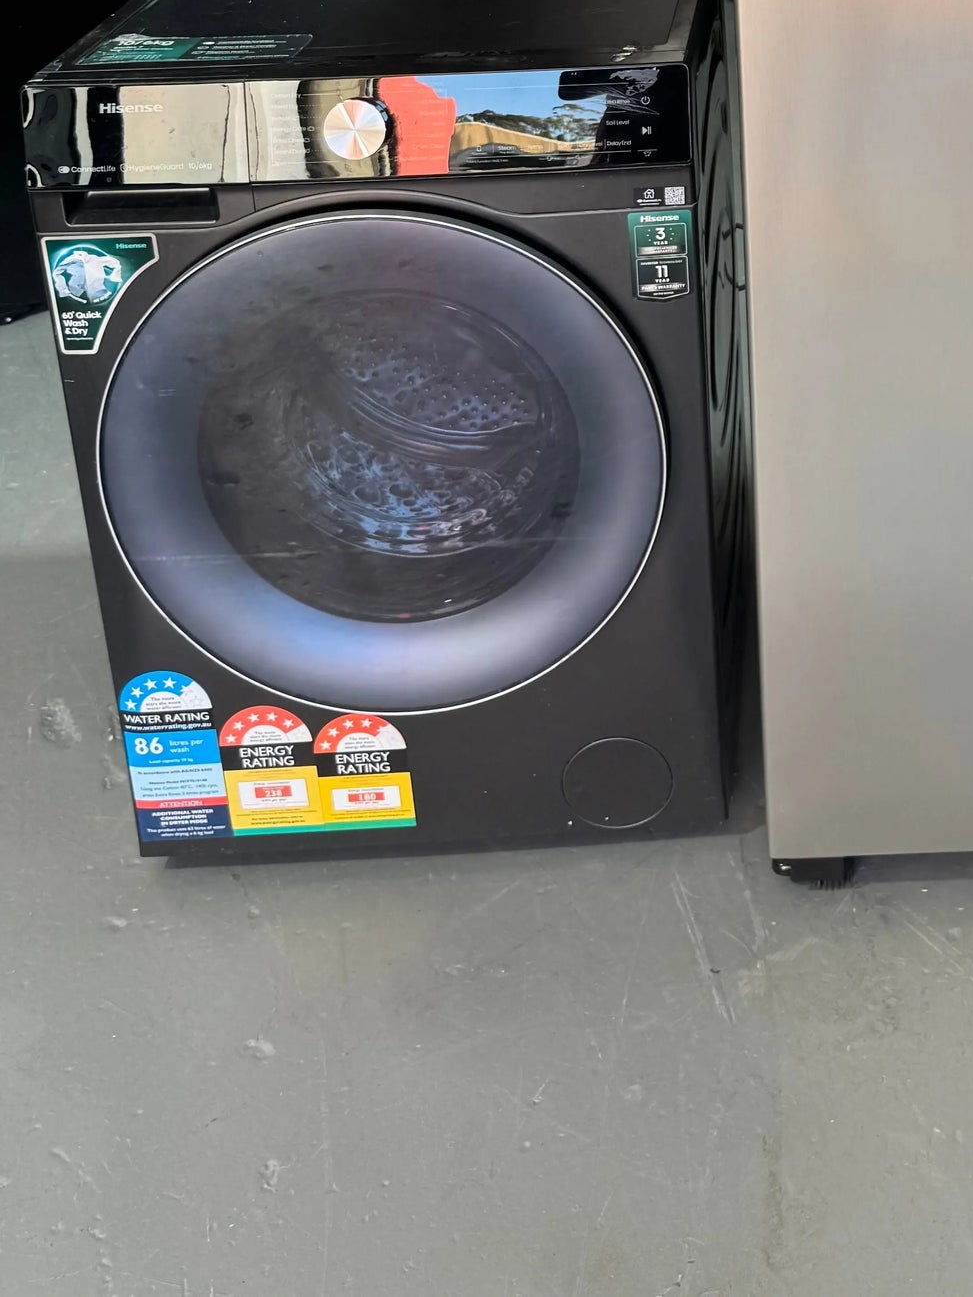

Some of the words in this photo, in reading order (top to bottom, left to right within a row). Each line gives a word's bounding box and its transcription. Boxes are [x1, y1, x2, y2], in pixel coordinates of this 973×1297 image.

[99, 103, 163, 113] Hisense
[655, 227, 665, 240] 3
[656, 265, 668, 278] 11
[76, 311, 102, 319] Quick
[124, 714, 162, 723] WATER
[165, 712, 210, 722] RATING
[125, 722, 211, 731] www.waterrating.gov.au
[134, 737, 163, 755] 86
[240, 745, 294, 757] ENERGY
[242, 756, 294, 768] RATING
[336, 752, 389, 764] ENERGY
[337, 763, 391, 774] RATING
[160, 800, 203, 808] ATTENTION
